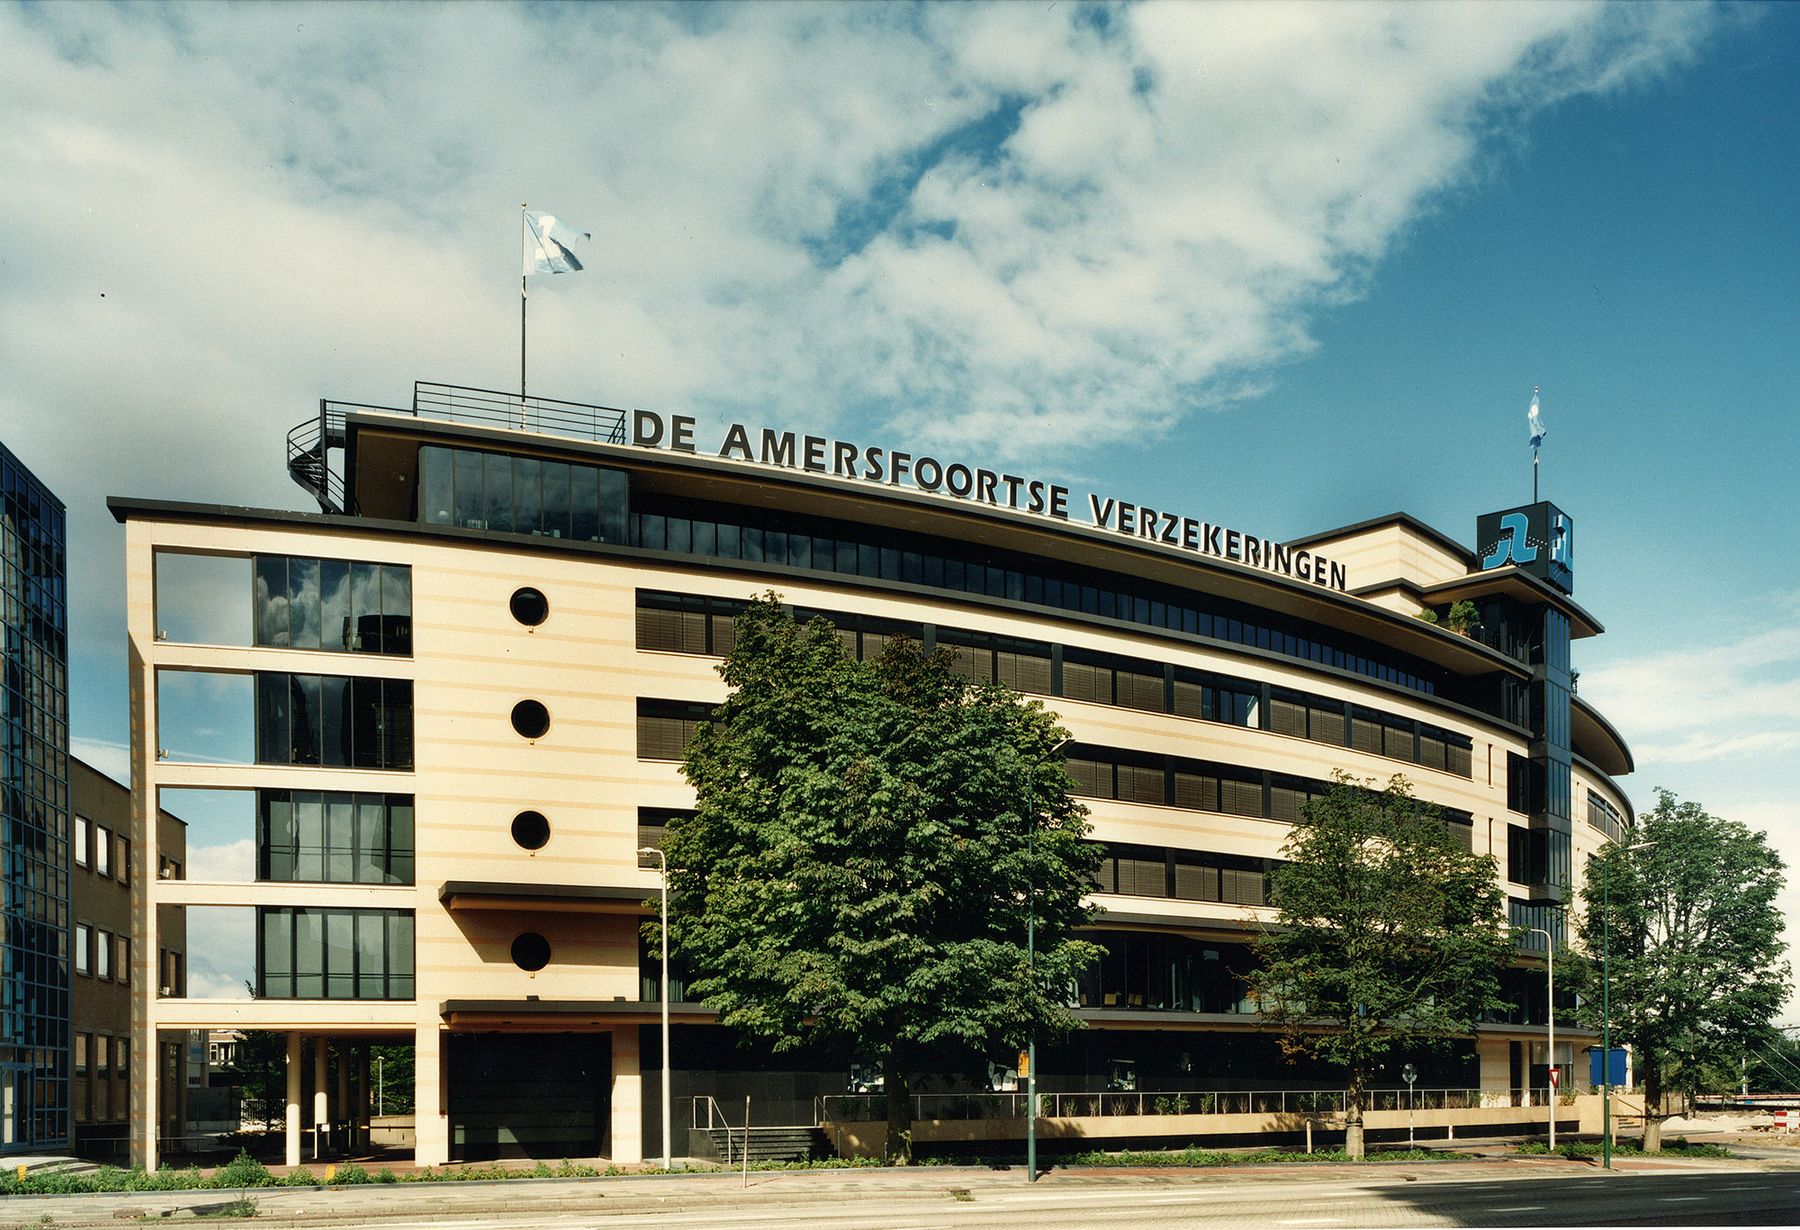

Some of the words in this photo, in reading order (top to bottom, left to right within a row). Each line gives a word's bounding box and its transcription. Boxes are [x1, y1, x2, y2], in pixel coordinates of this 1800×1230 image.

[632, 409, 696, 452] DE
[717, 423, 1069, 520] AMERSFOORTSE
[1088, 493, 1346, 591] VERZEKERINGEN
